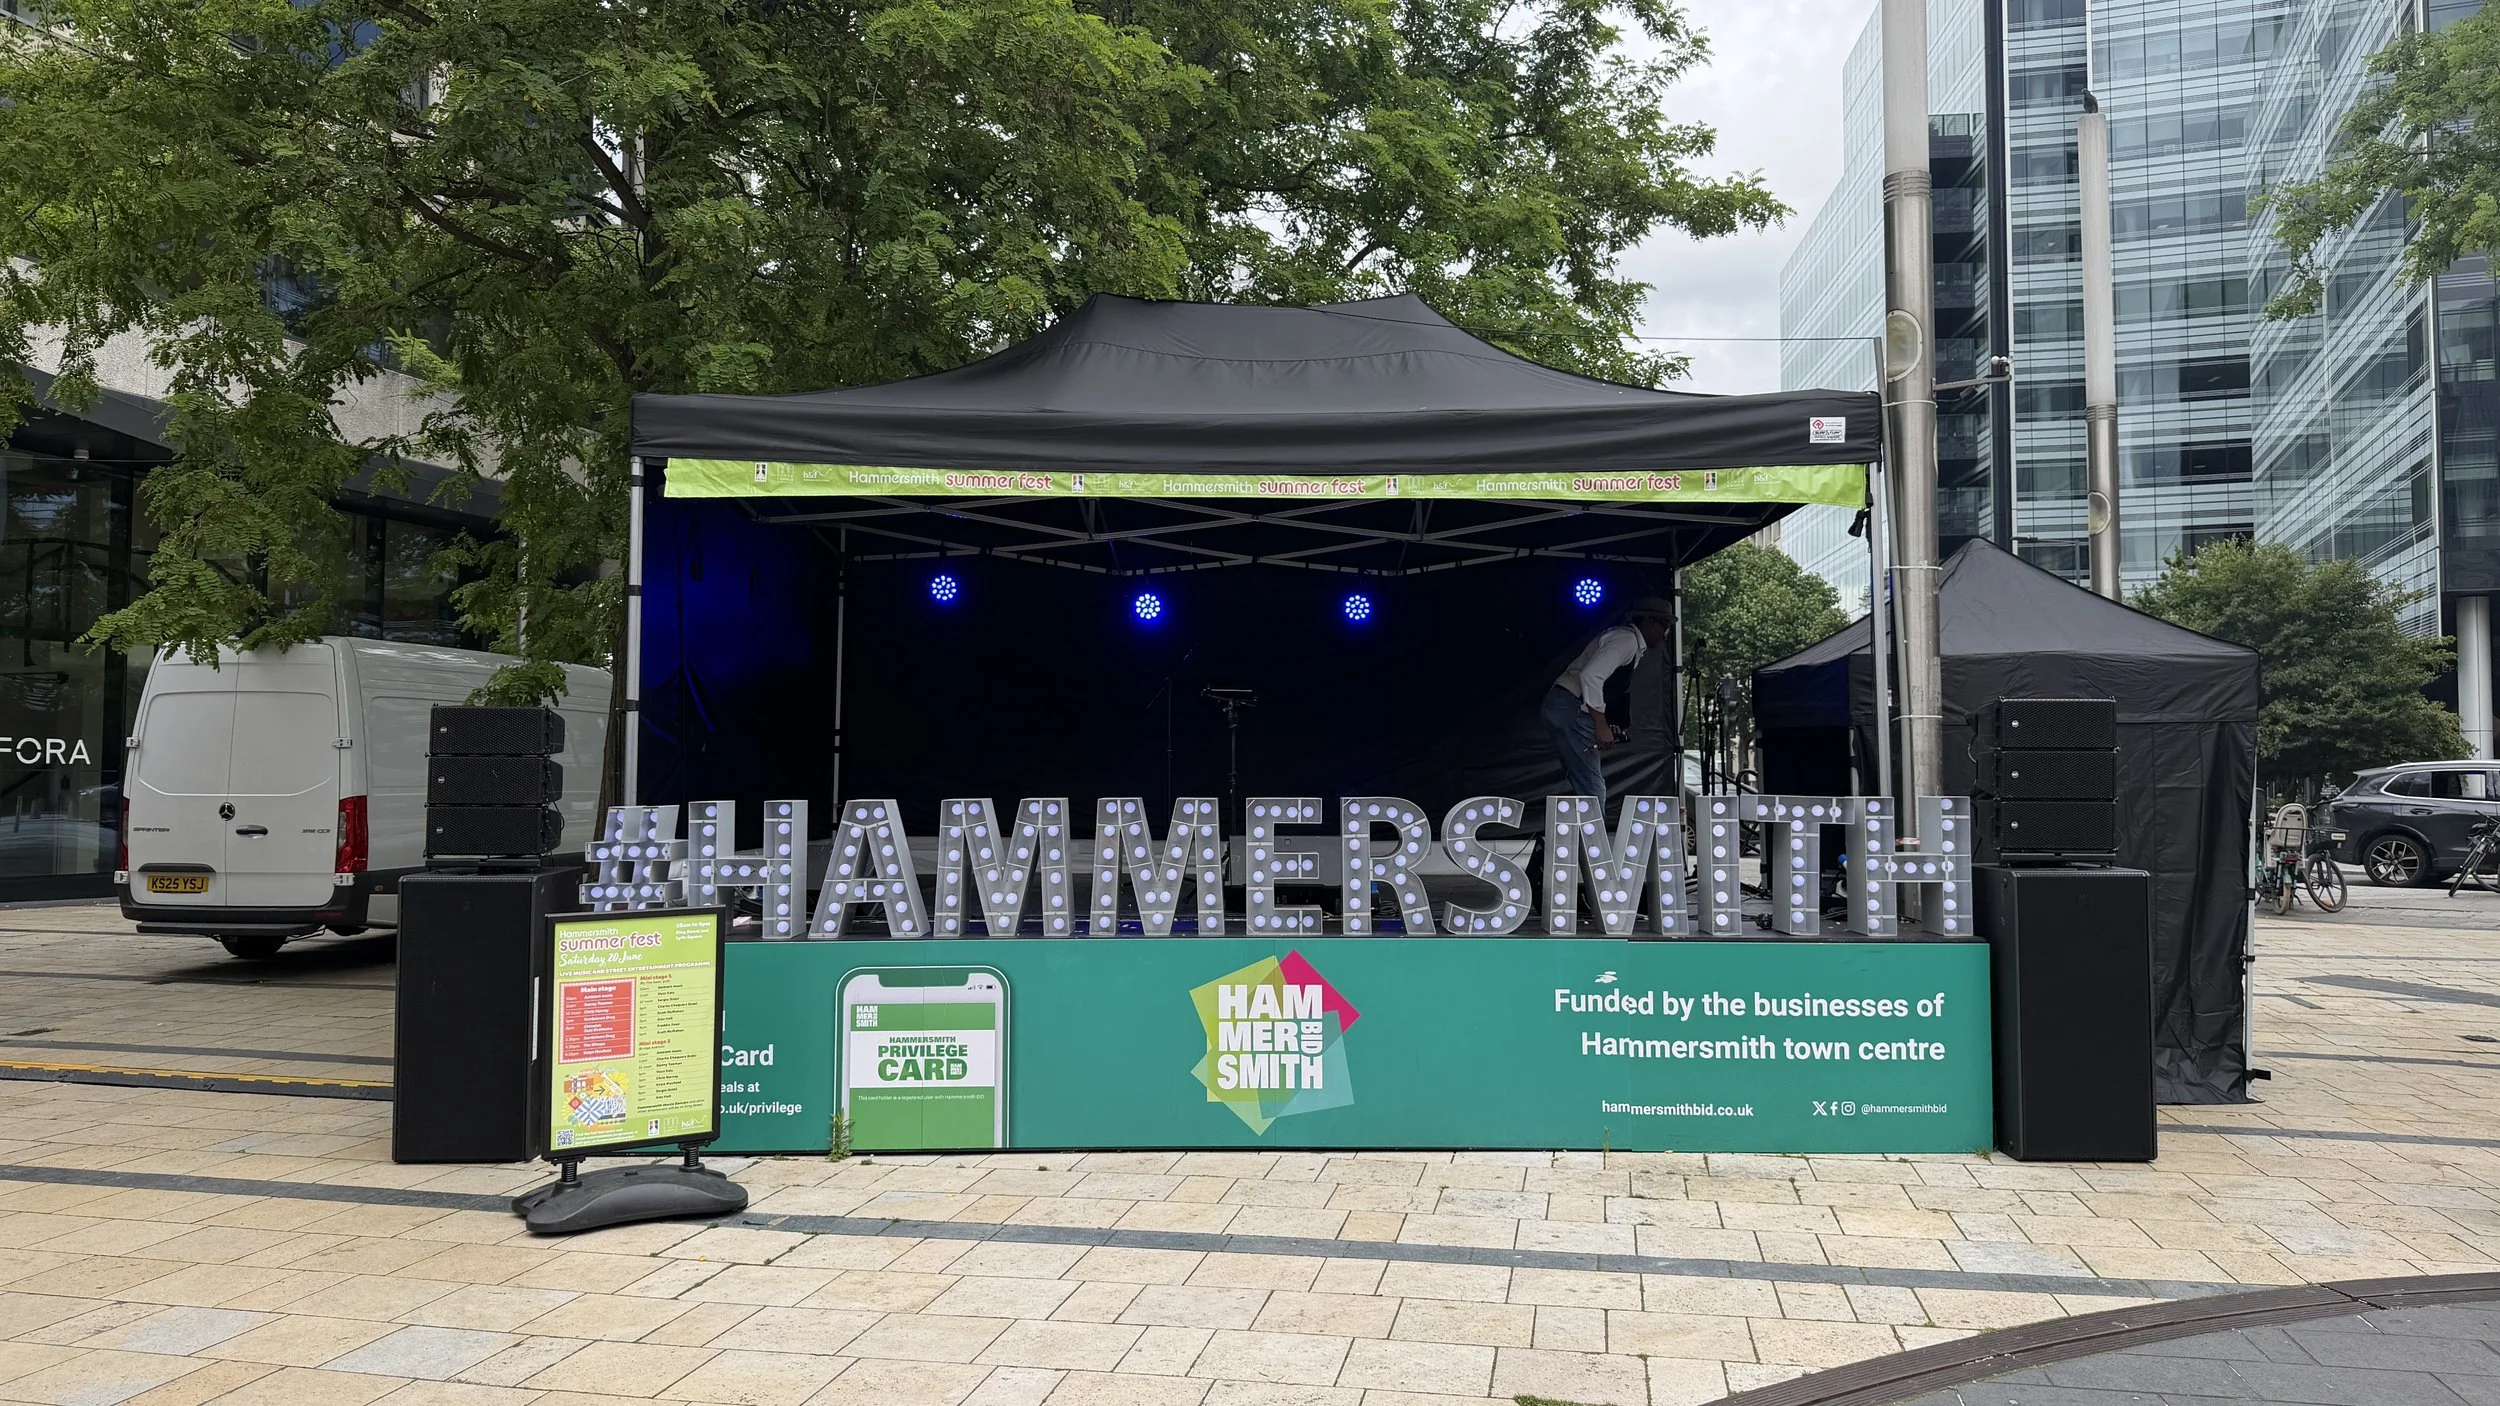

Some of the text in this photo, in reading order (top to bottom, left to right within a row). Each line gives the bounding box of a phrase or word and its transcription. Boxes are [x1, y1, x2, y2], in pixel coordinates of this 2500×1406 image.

[849, 470, 1053, 490] Hammersmith summer fest
[1163, 478, 1366, 495] Hammersmith summer fest
[1476, 473, 1681, 492] Hammersmith summer fest
[579, 795, 1974, 939] #HAMMERSMITH
[150, 876, 205, 890] KS25 YSJ
[559, 928, 618, 938] Hammersmith
[560, 932, 662, 952] summer fest
[559, 951, 642, 967] Saturday 20 June
[627, 964, 674, 972] ENTERTAINMENT
[1218, 984, 1322, 1019] HAM
[1554, 988, 1944, 1022] Funded by the businesses of
[1218, 1022, 1322, 1054] MER BID
[1582, 1032, 1946, 1061] Hammersmith town centre
[722, 1044, 774, 1066] Card
[878, 1044, 968, 1057] PRIVILEGE
[877, 1058, 968, 1081] CARD
[1218, 1054, 1322, 1090] SMITH
[720, 1081, 760, 1092] eals at
[720, 1102, 802, 1116] o.uk/privilege
[1602, 1100, 1754, 1117] hammersmithbid.co.uk
[1861, 1104, 1947, 1115] @hammersmithbid
